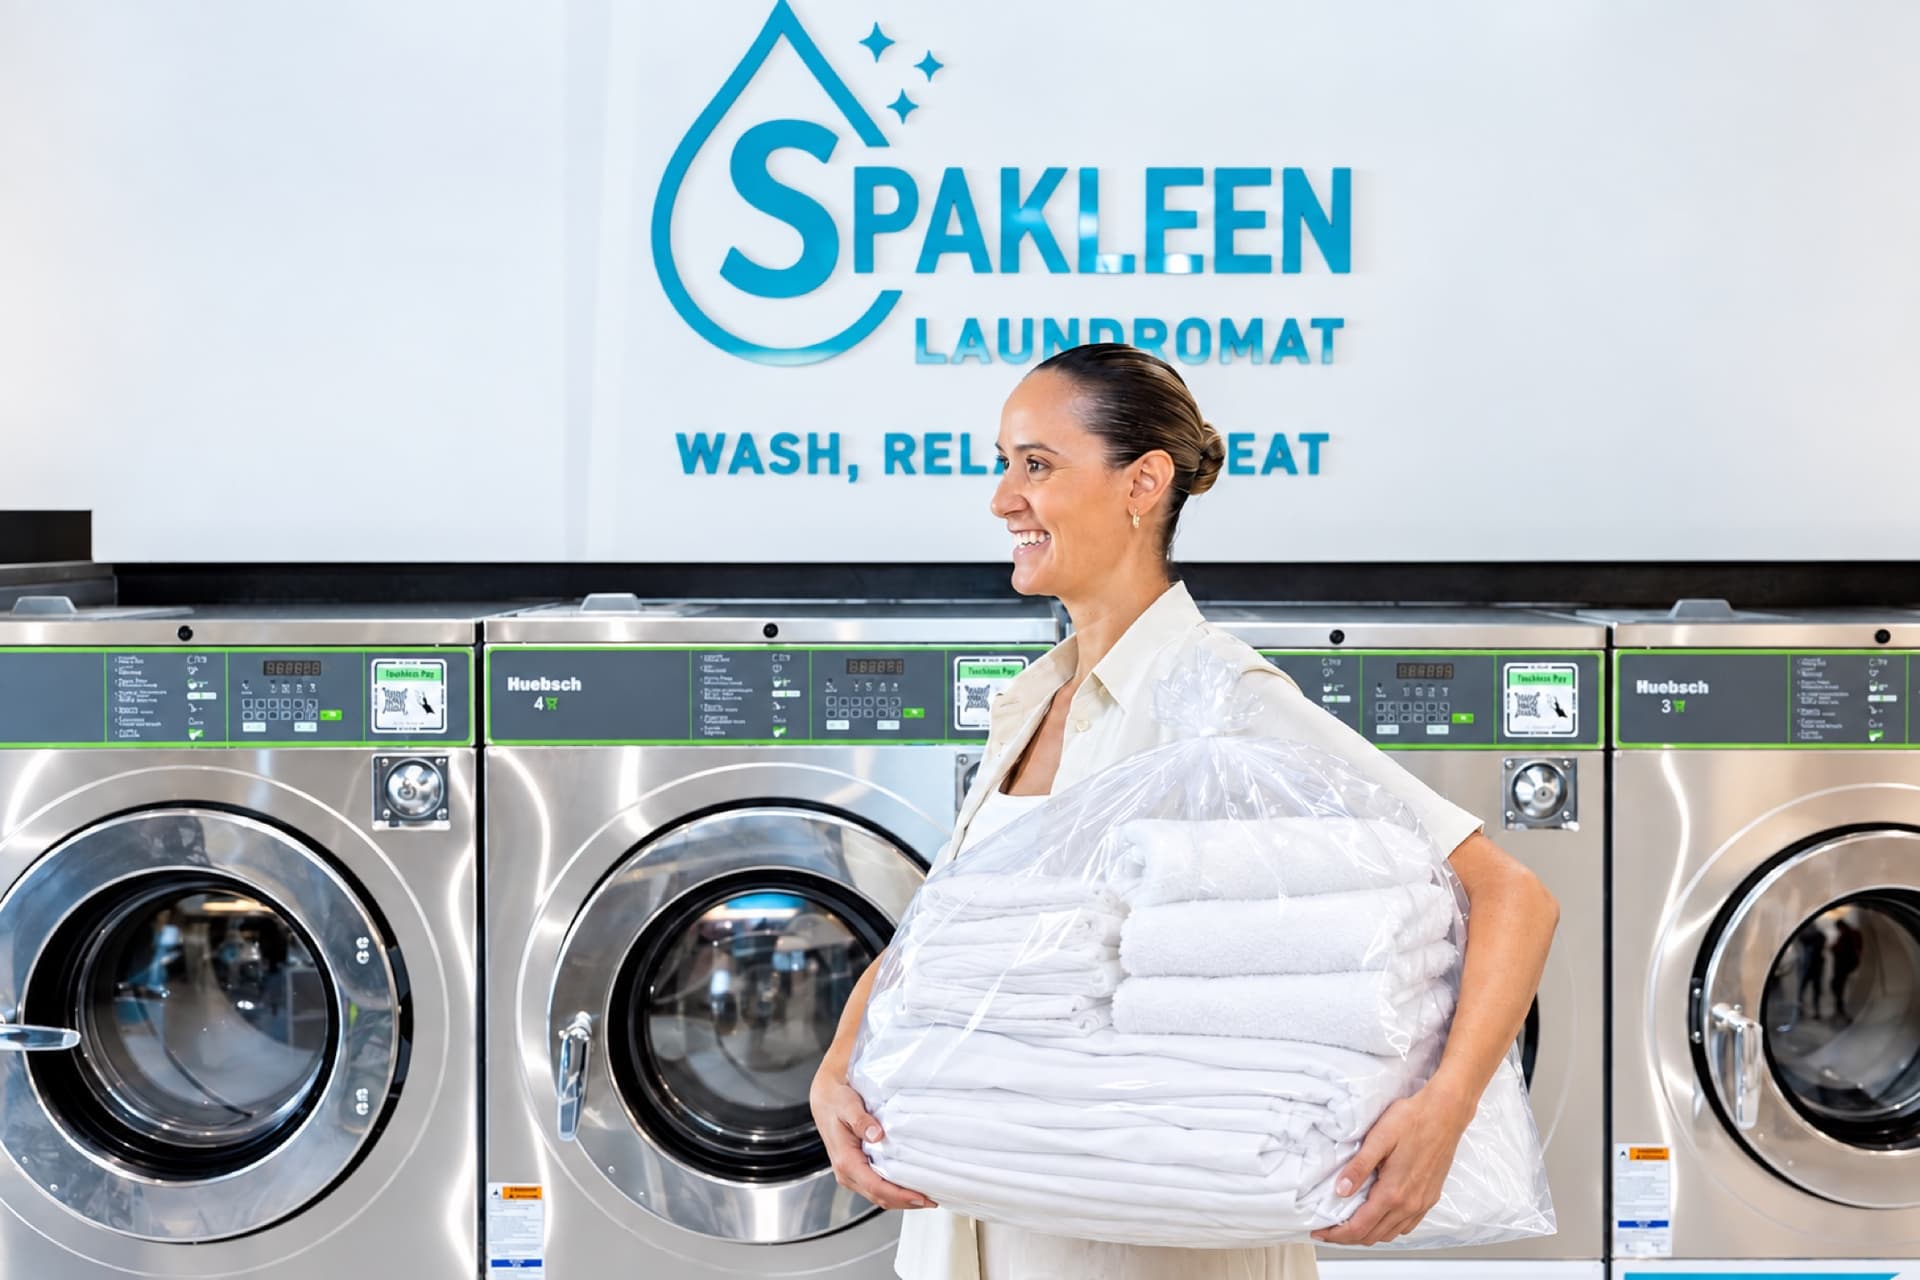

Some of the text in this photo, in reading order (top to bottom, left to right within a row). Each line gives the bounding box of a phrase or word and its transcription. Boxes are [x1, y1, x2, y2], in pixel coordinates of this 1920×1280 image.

[719, 118, 1352, 300] SPAKLEEN
[675, 431, 860, 485] WASH,
[883, 431, 1005, 477] REL
[507, 676, 582, 692] Huebsch
[1636, 679, 1709, 695] Huebsch
[533, 695, 544, 711] 4
[1661, 698, 1672, 714] 3
